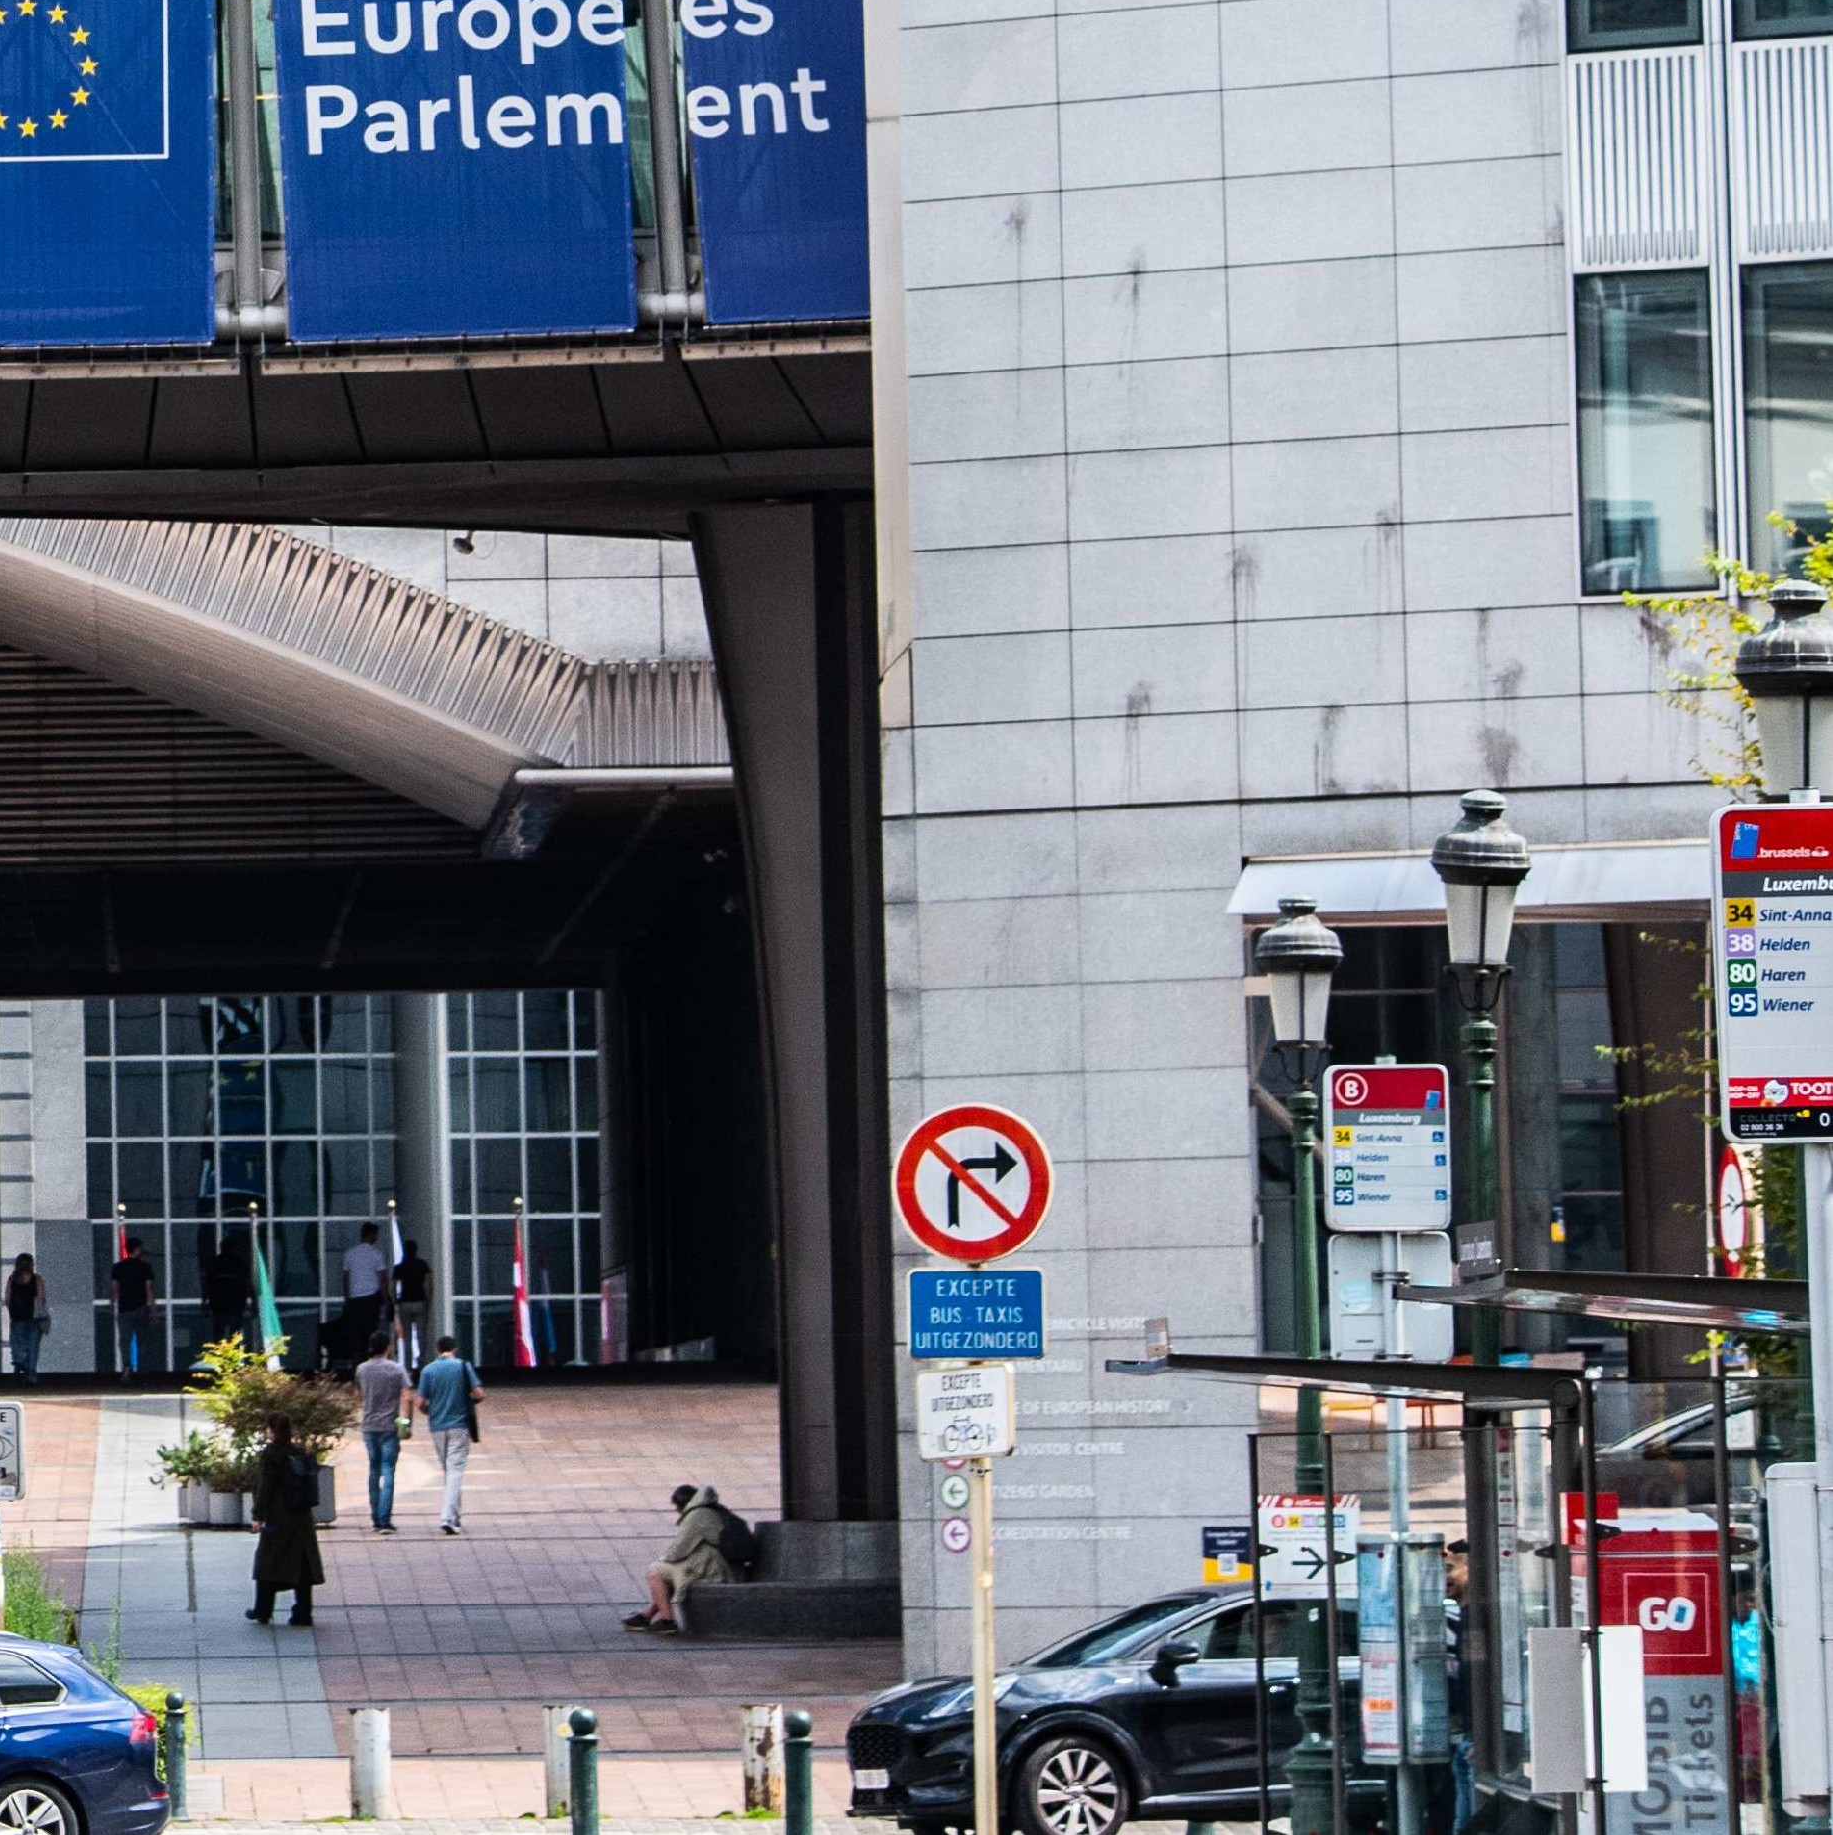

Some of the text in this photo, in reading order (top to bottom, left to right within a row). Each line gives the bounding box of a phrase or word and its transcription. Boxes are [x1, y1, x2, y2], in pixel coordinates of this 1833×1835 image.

[304, 66, 830, 156] Parlement
[1728, 905, 1832, 922] 34 Sint-Anna
[1728, 933, 1810, 952] 38 Helden
[1730, 963, 1806, 983] 80 Haren
[1730, 993, 1815, 1012] 95 Wiener
[1344, 1080, 1359, 1098] B
[1358, 1113, 1422, 1125] Luxemburg
[1335, 1131, 1351, 1142] 34
[1335, 1168, 1351, 1182] 80
[1336, 1189, 1354, 1203] 95
[935, 1279, 1017, 1297] EXCEPTE
[930, 1306, 1024, 1323] BUS TAXIS
[915, 1331, 1039, 1349] UITGEZONDERD
[941, 1372, 983, 1391] EXCEPTE
[932, 1393, 994, 1413] UITGEZONDERD
